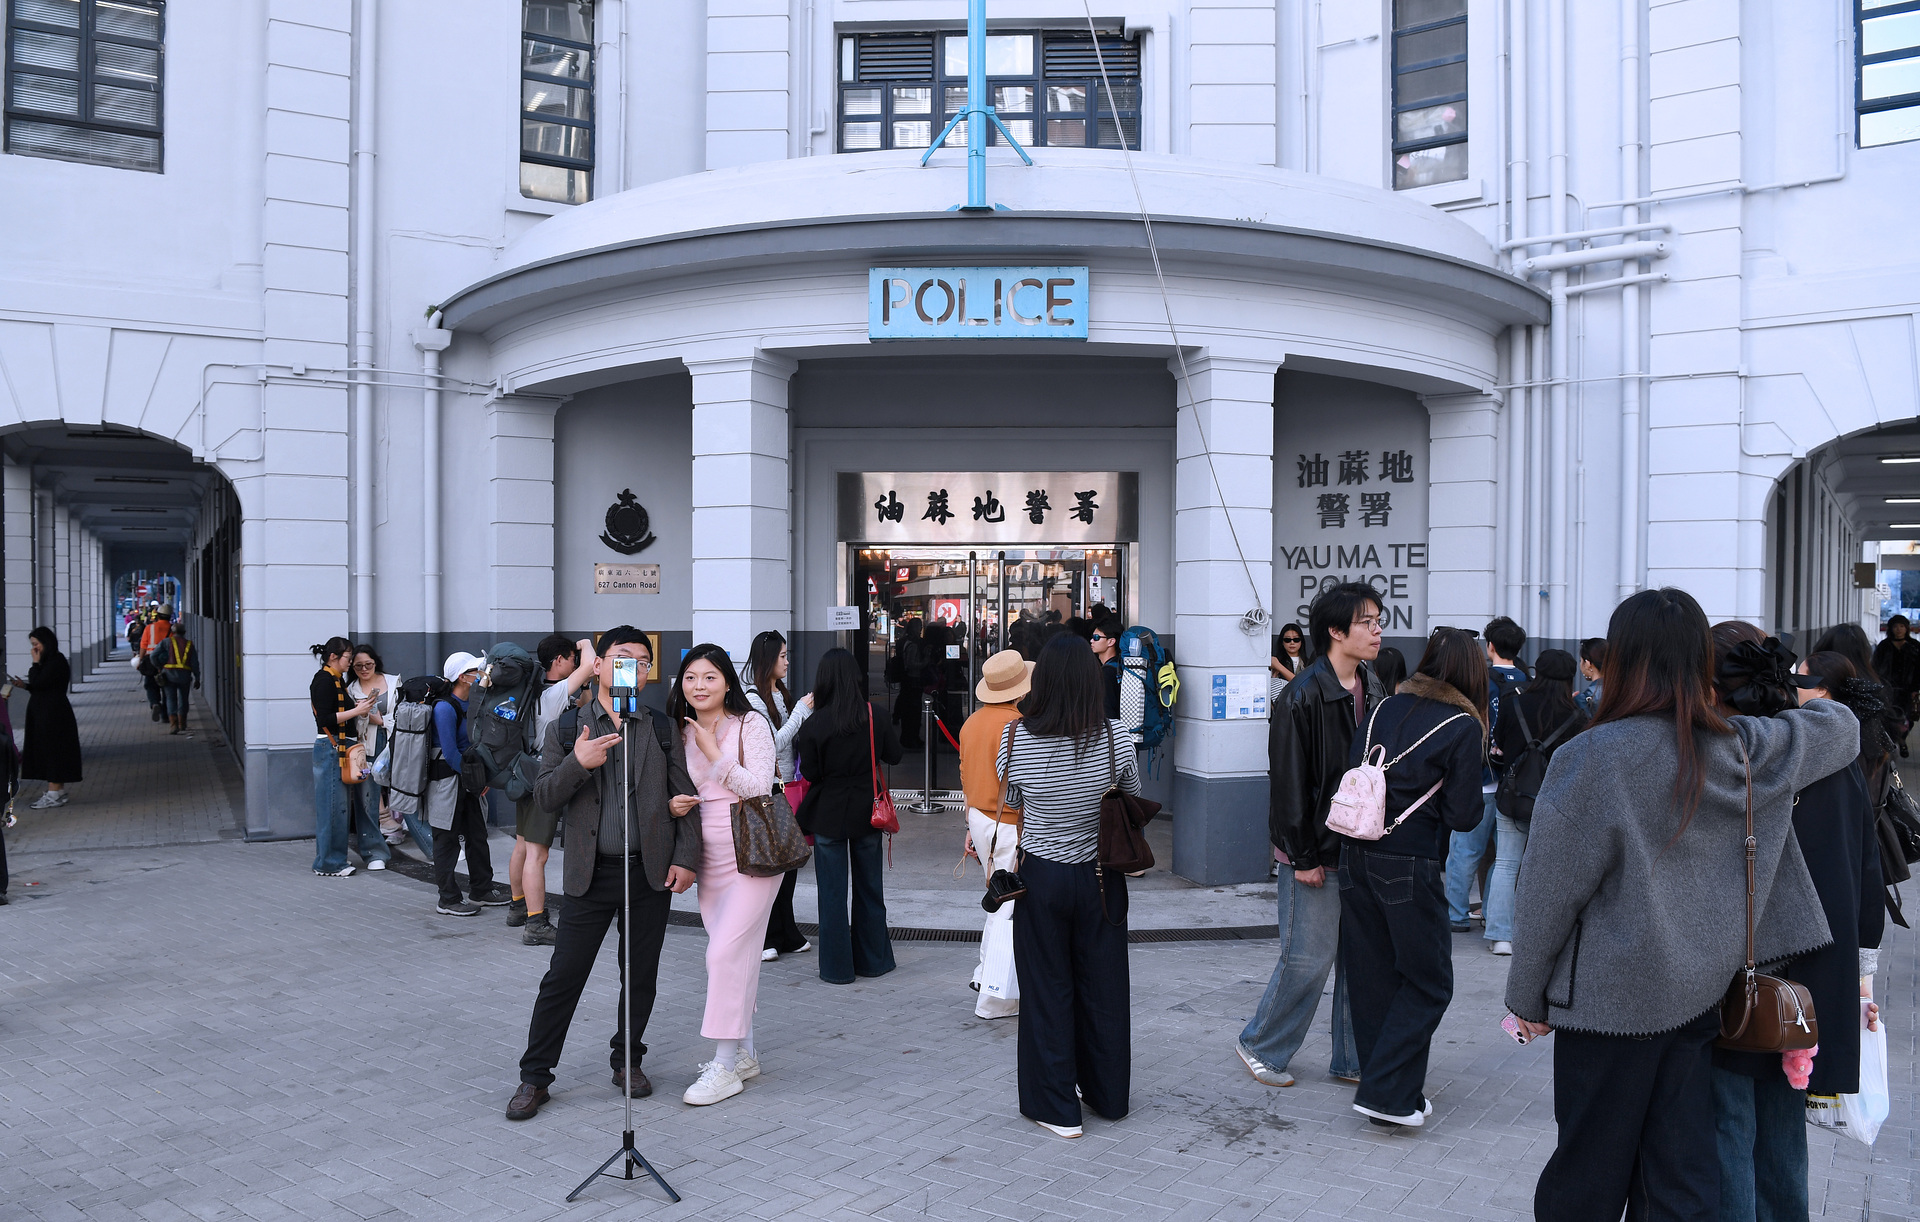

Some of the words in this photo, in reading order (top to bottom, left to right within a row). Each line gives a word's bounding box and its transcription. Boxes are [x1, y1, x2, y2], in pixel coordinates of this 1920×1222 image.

[882, 278, 1075, 326] POLICE
[1297, 450, 1414, 488] 油蔴地
[1317, 491, 1392, 529] 警署
[1280, 545, 1331, 570] YAU
[1337, 544, 1382, 568] MA
